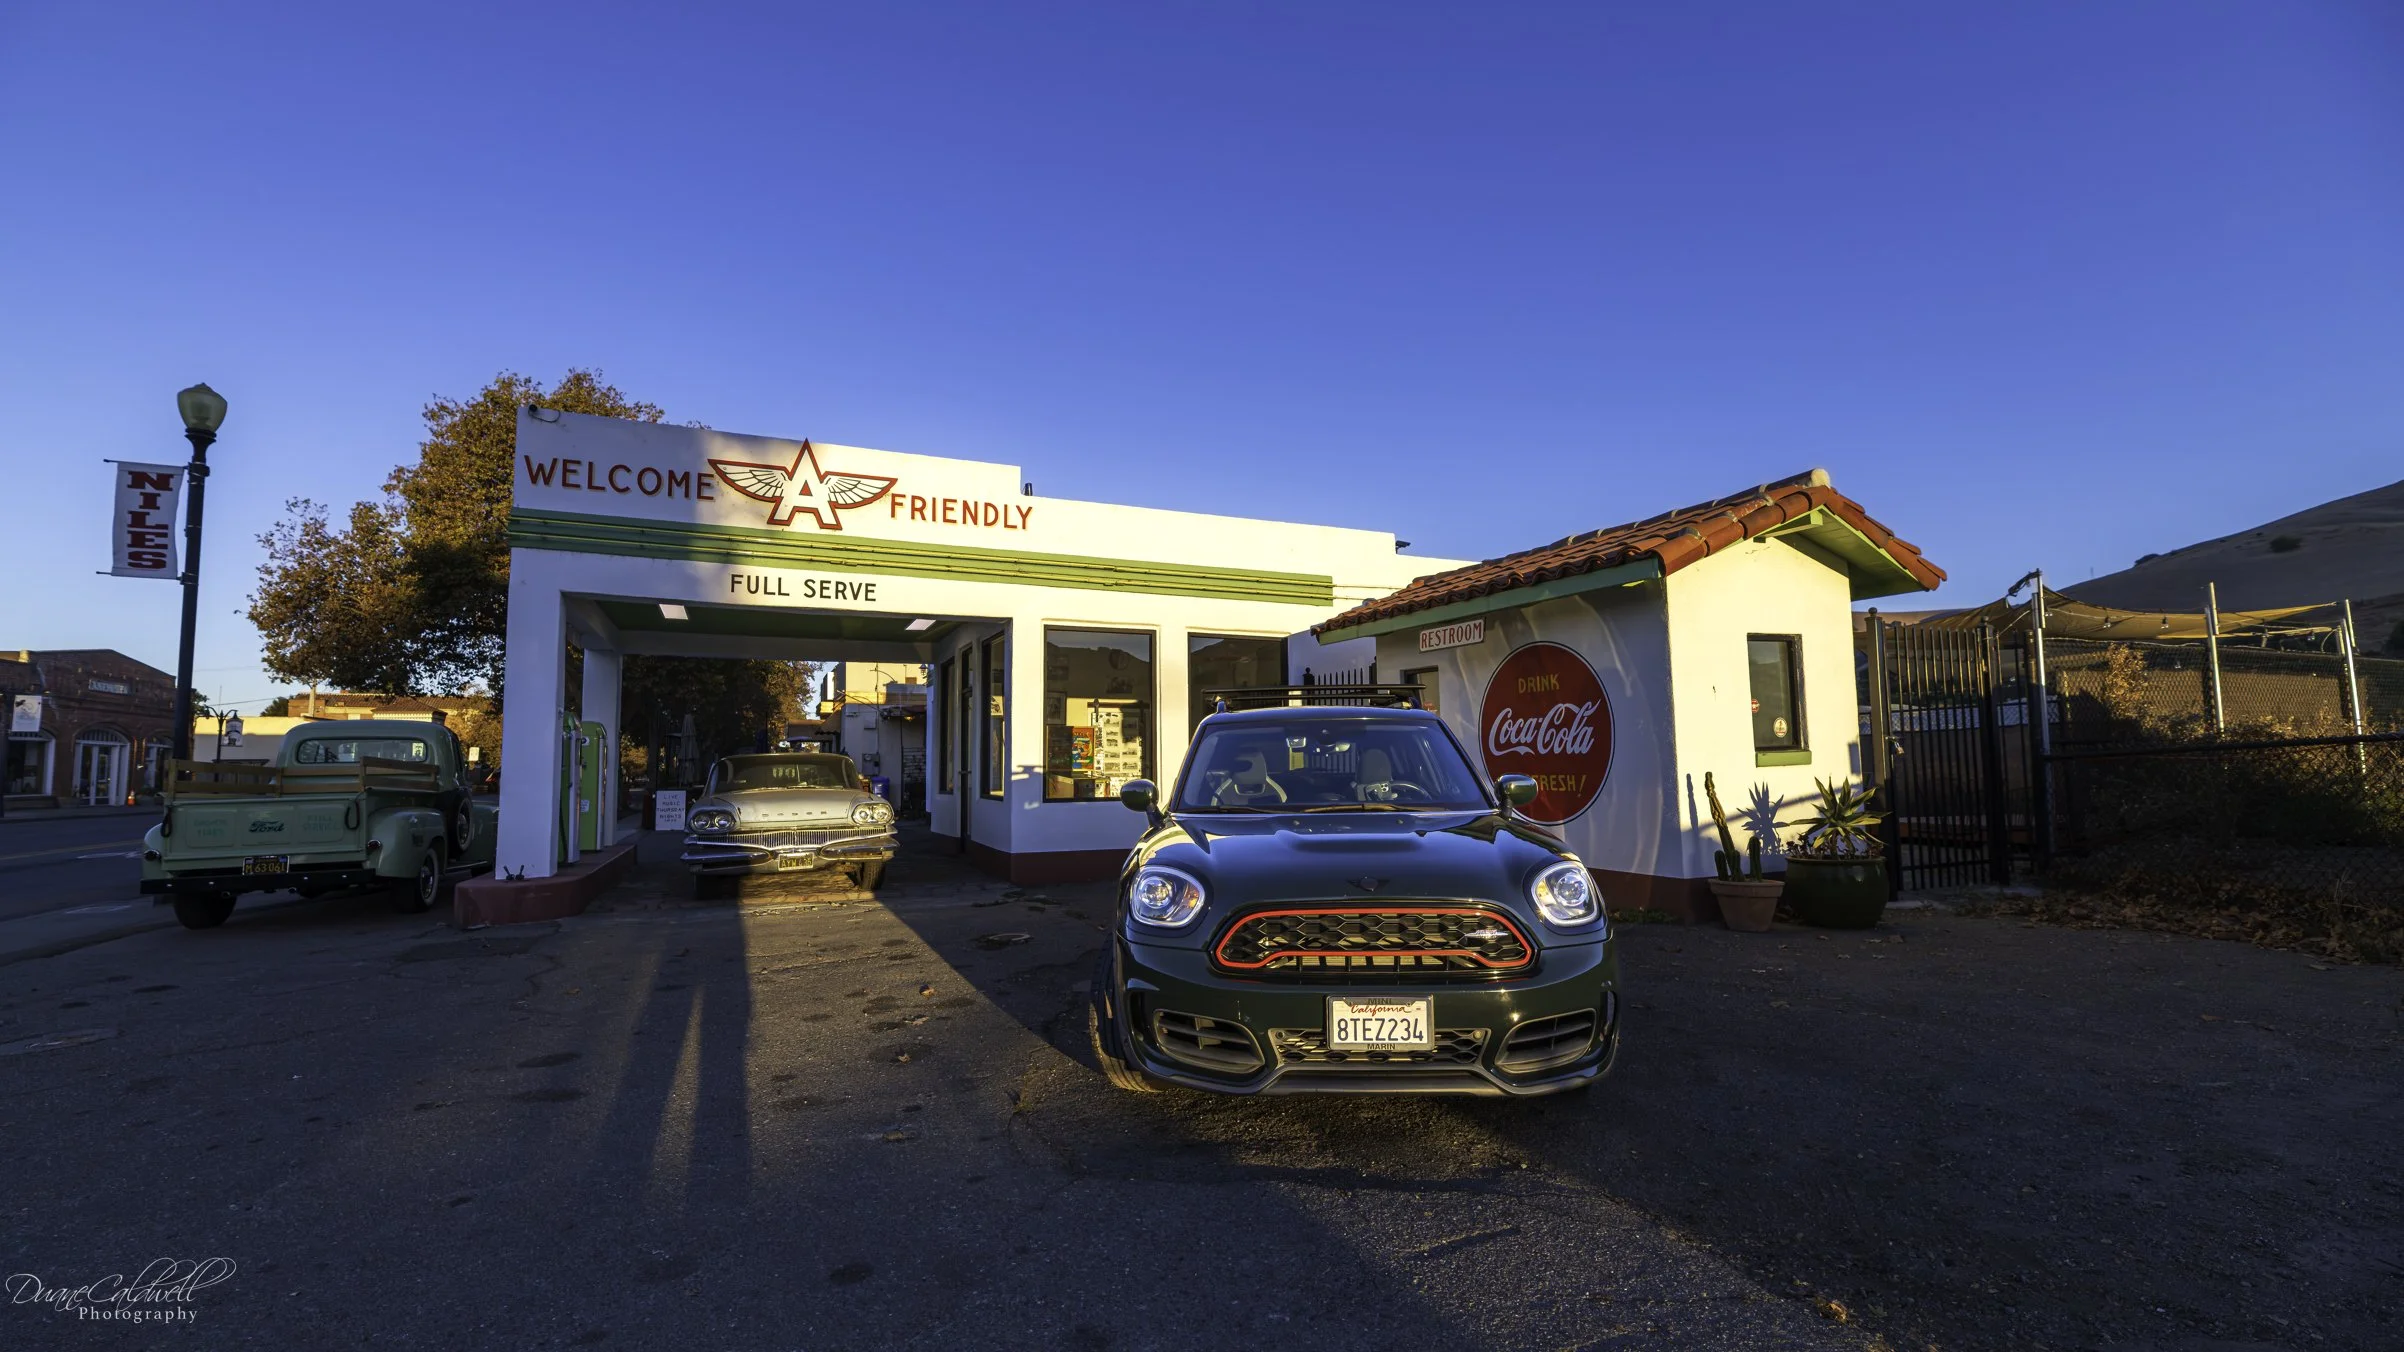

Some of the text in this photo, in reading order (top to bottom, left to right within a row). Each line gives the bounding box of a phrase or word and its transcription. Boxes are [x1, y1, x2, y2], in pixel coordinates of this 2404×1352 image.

[524, 455, 715, 501] WELCOME
[127, 470, 175, 569] NILES
[890, 493, 1033, 530] FRIENDLY
[730, 573, 877, 602] FULL SERVE
[1421, 622, 1482, 648] RESTROOM
[1517, 672, 1561, 694] DRINK
[1488, 698, 1601, 757] Coca-Cola
[1532, 774, 1588, 798] RESH!
[248, 819, 286, 833] Ford
[1350, 1003, 1412, 1016] California
[1337, 1018, 1424, 1042] 8TEZ234
